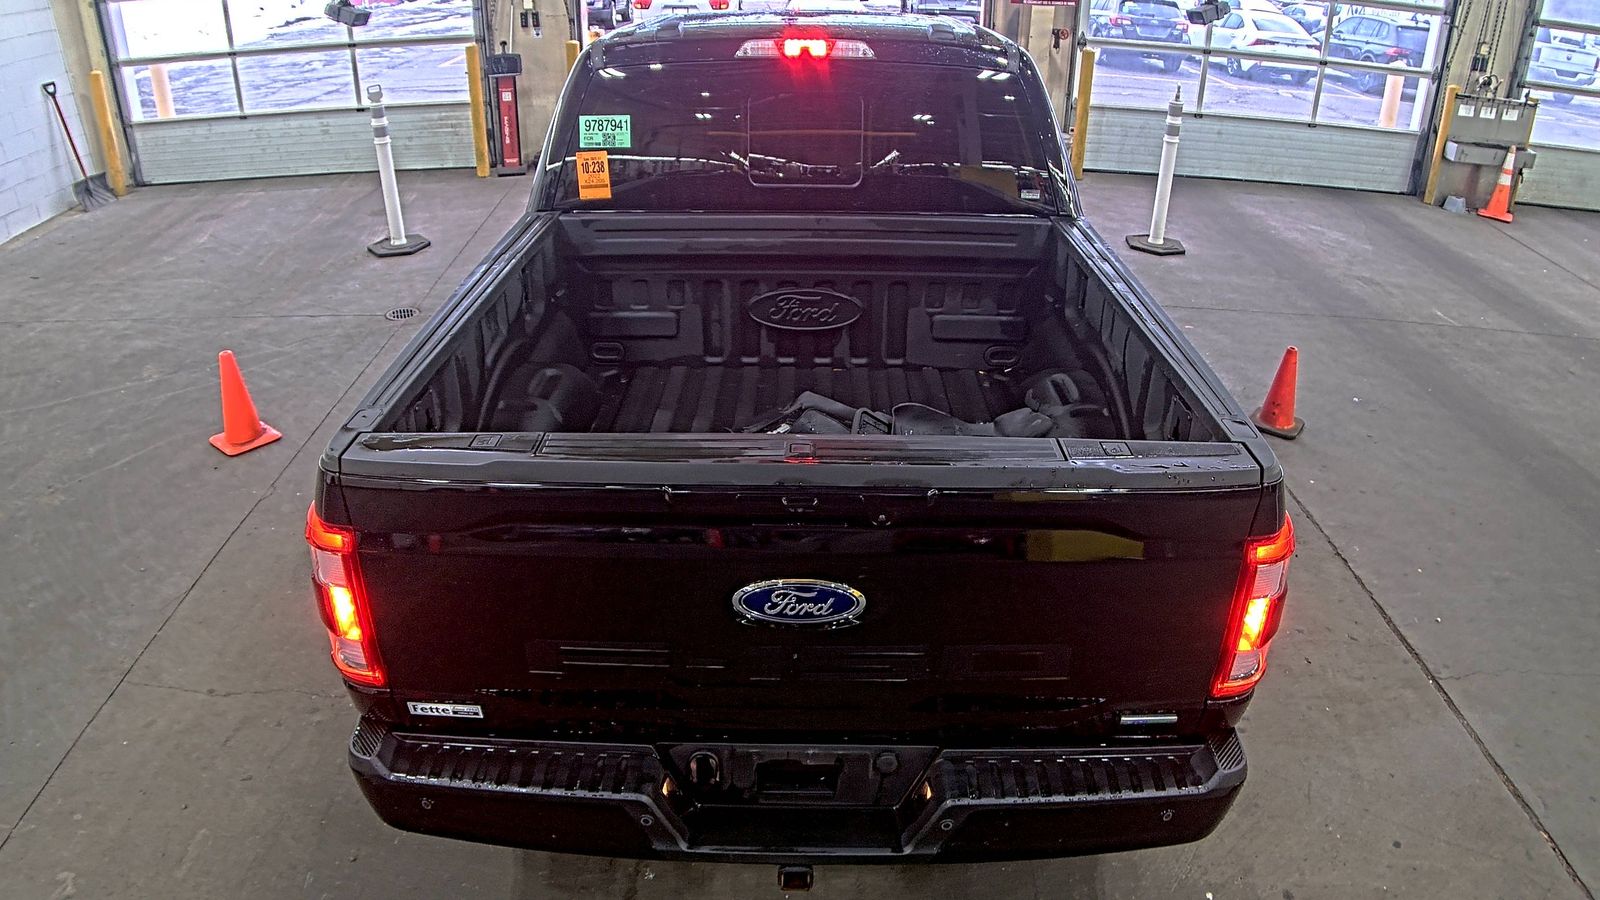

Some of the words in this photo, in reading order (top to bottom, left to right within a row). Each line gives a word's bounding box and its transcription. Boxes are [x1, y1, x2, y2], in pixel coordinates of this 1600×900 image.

[584, 119, 629, 132] 9787941
[581, 161, 605, 174] 10:238
[769, 294, 840, 322] Ford
[764, 589, 835, 616] Ford
[412, 704, 451, 715] Fette
